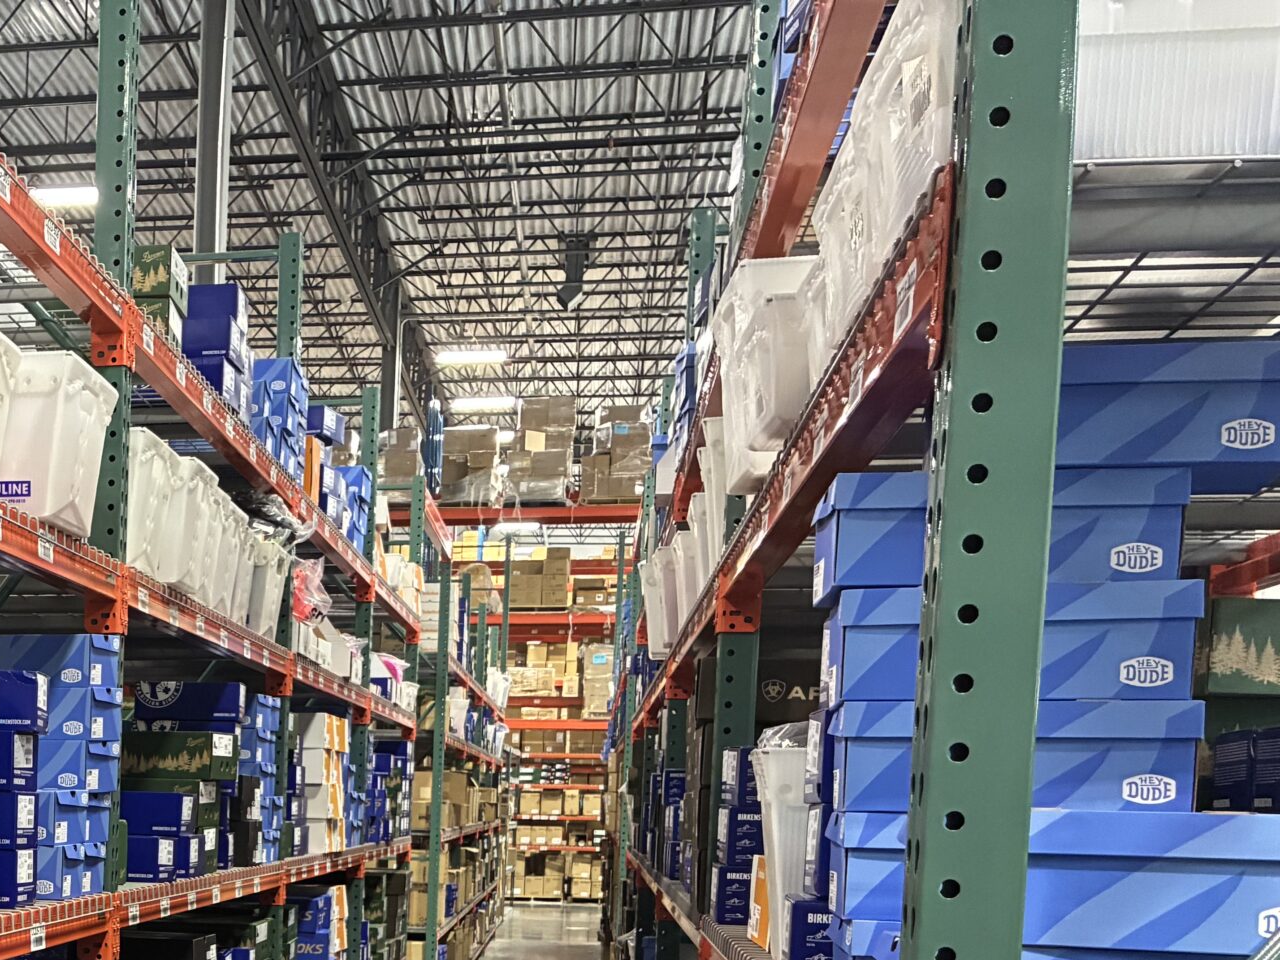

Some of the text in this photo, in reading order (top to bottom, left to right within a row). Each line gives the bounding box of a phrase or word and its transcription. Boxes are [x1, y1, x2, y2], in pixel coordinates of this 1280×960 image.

[1239, 420, 1261, 430] HEY
[1225, 426, 1272, 446] DUDE
[1127, 545, 1150, 555] HEY
[1114, 551, 1160, 570] DUDE
[1137, 658, 1160, 668] HEY
[1124, 665, 1170, 684] DUDE
[1138, 777, 1162, 786] HEY
[1126, 782, 1173, 802] DUDE
